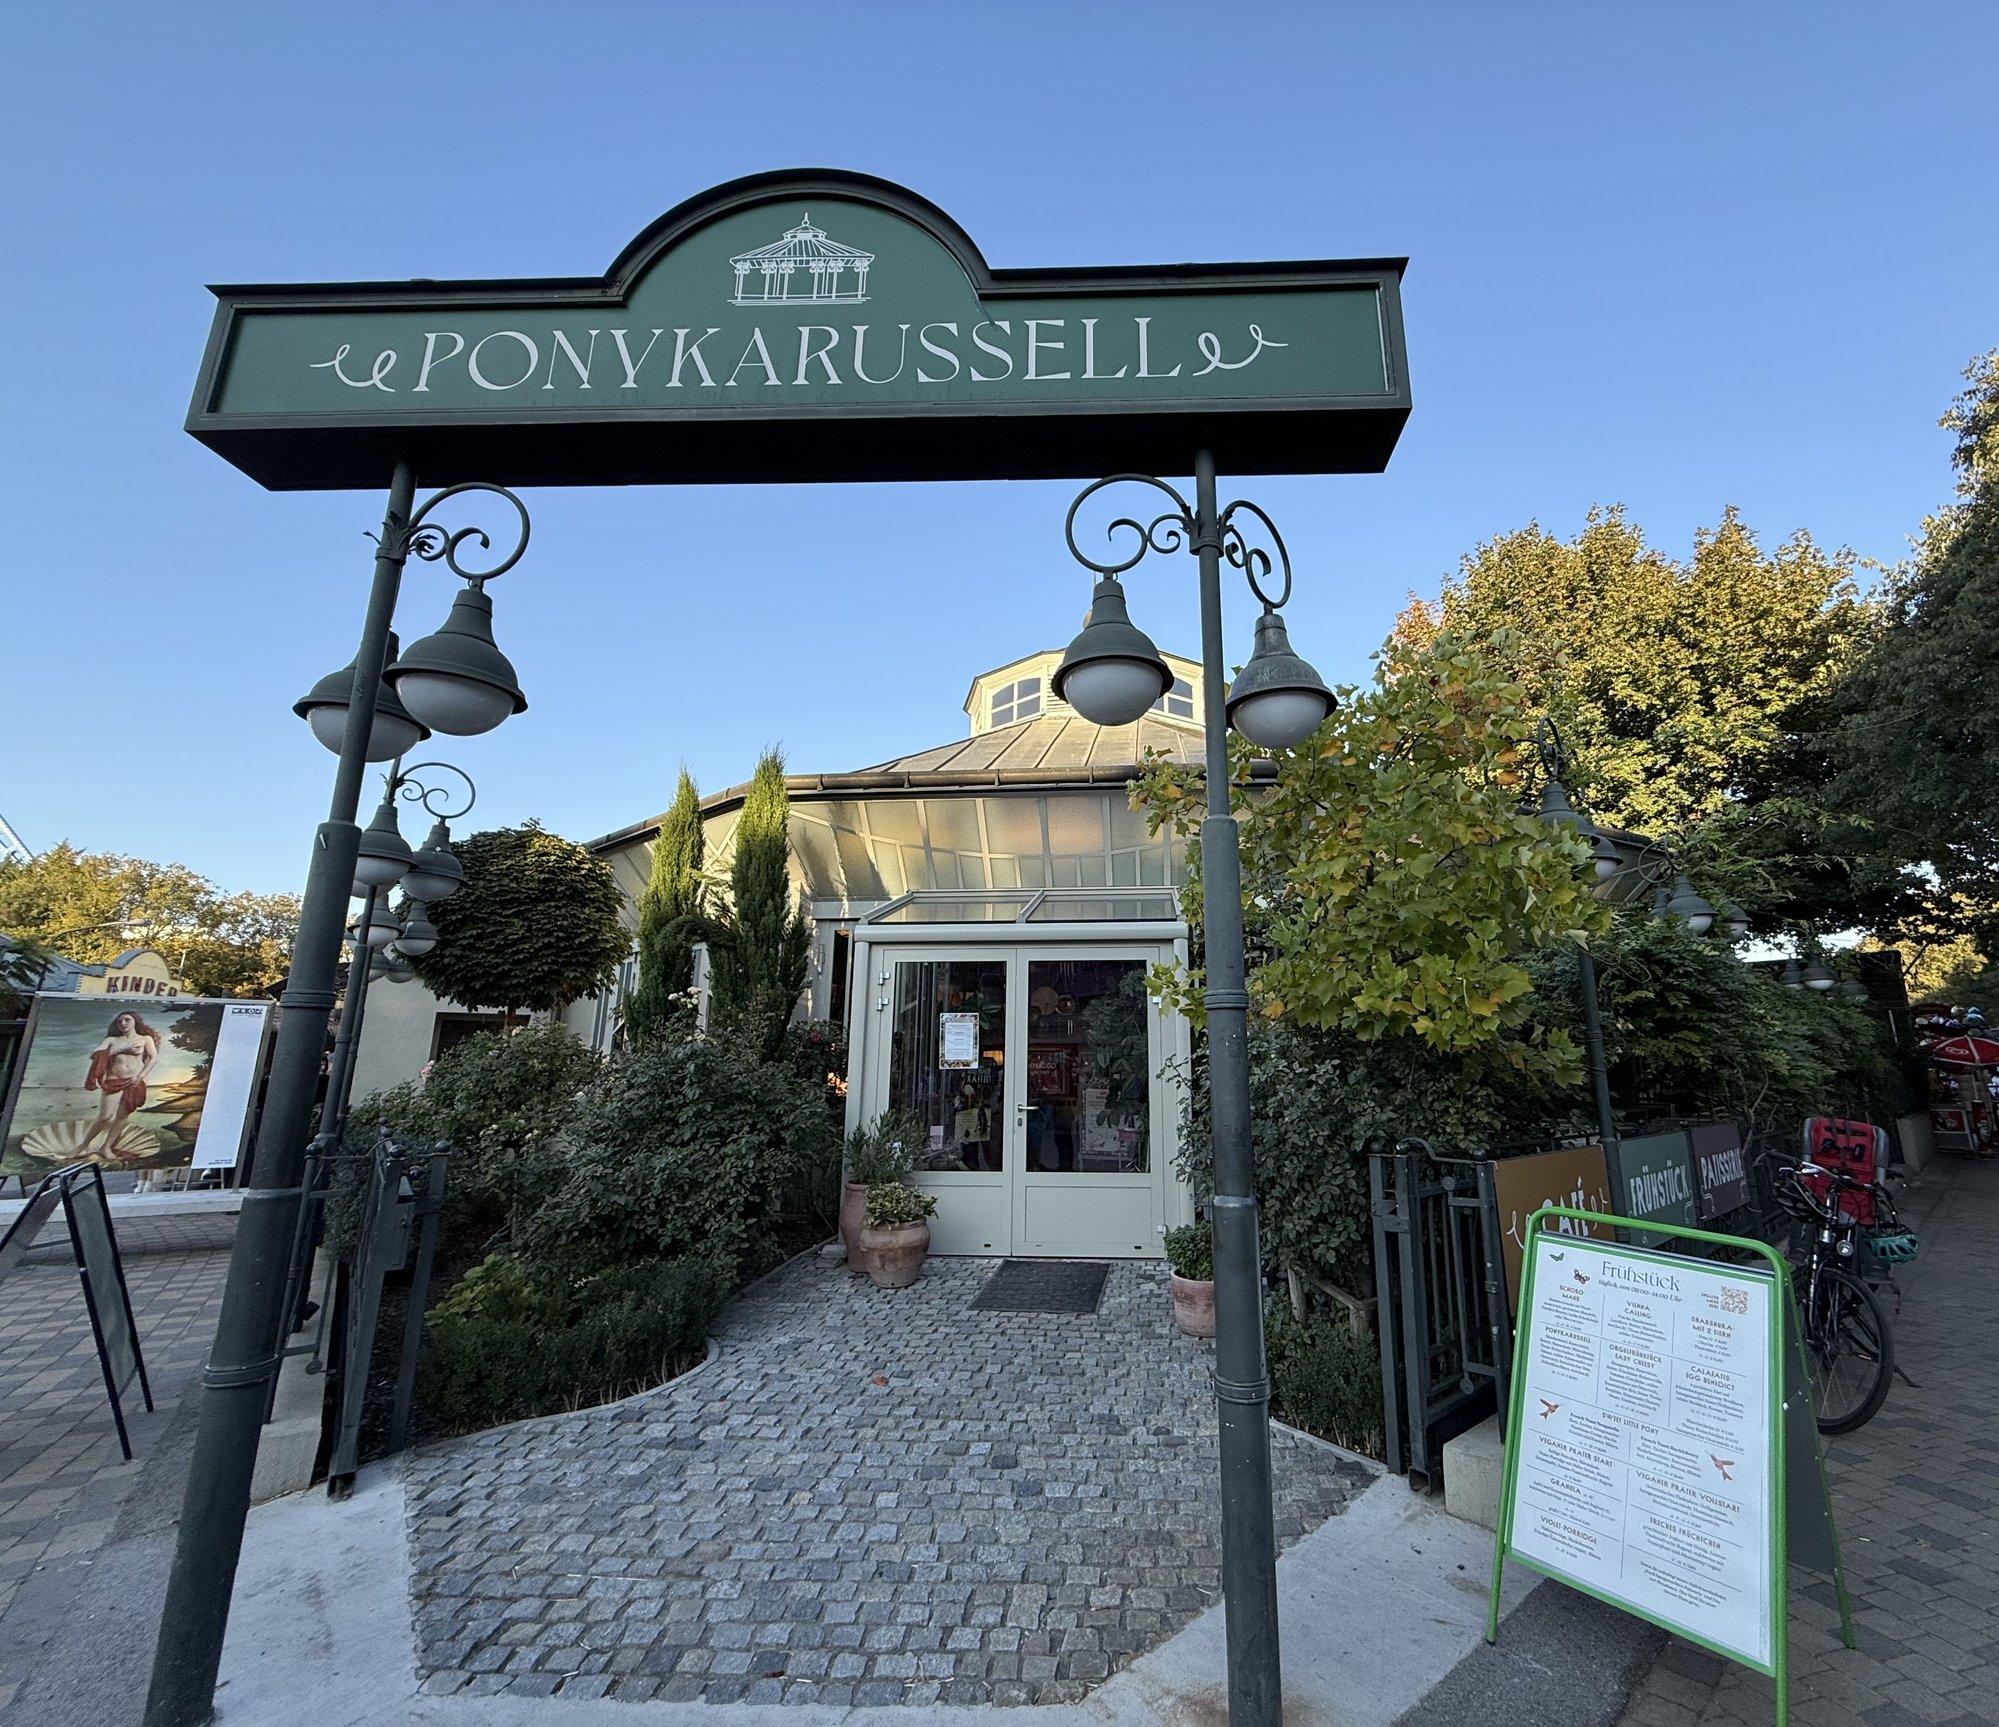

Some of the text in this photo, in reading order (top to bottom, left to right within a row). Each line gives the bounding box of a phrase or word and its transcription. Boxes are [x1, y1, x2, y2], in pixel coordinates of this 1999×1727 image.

[412, 316, 1184, 391] PONYKARUSSELL
[1701, 1149, 1743, 1189] PATISSERIE
[1630, 1160, 1689, 1216] FRÜHSTÜCK
[1602, 1260, 1680, 1292] Frühstück
[1624, 1307, 1651, 1319] CALLING
[1626, 1300, 1650, 1311] VIENNA
[1691, 1316, 1732, 1331] SHAKSHUKA
[1692, 1324, 1705, 1332] MIT
[1545, 1326, 1591, 1343] PONYKARUSSELL
[1615, 1353, 1630, 1362] EASY
[1685, 1372, 1734, 1391] EGG BENEDICT
[1602, 1411, 1659, 1435] SWEET LITTLE PONY
[1569, 1446, 1591, 1460] PRATER
[1671, 1483, 1696, 1498] PRATER
